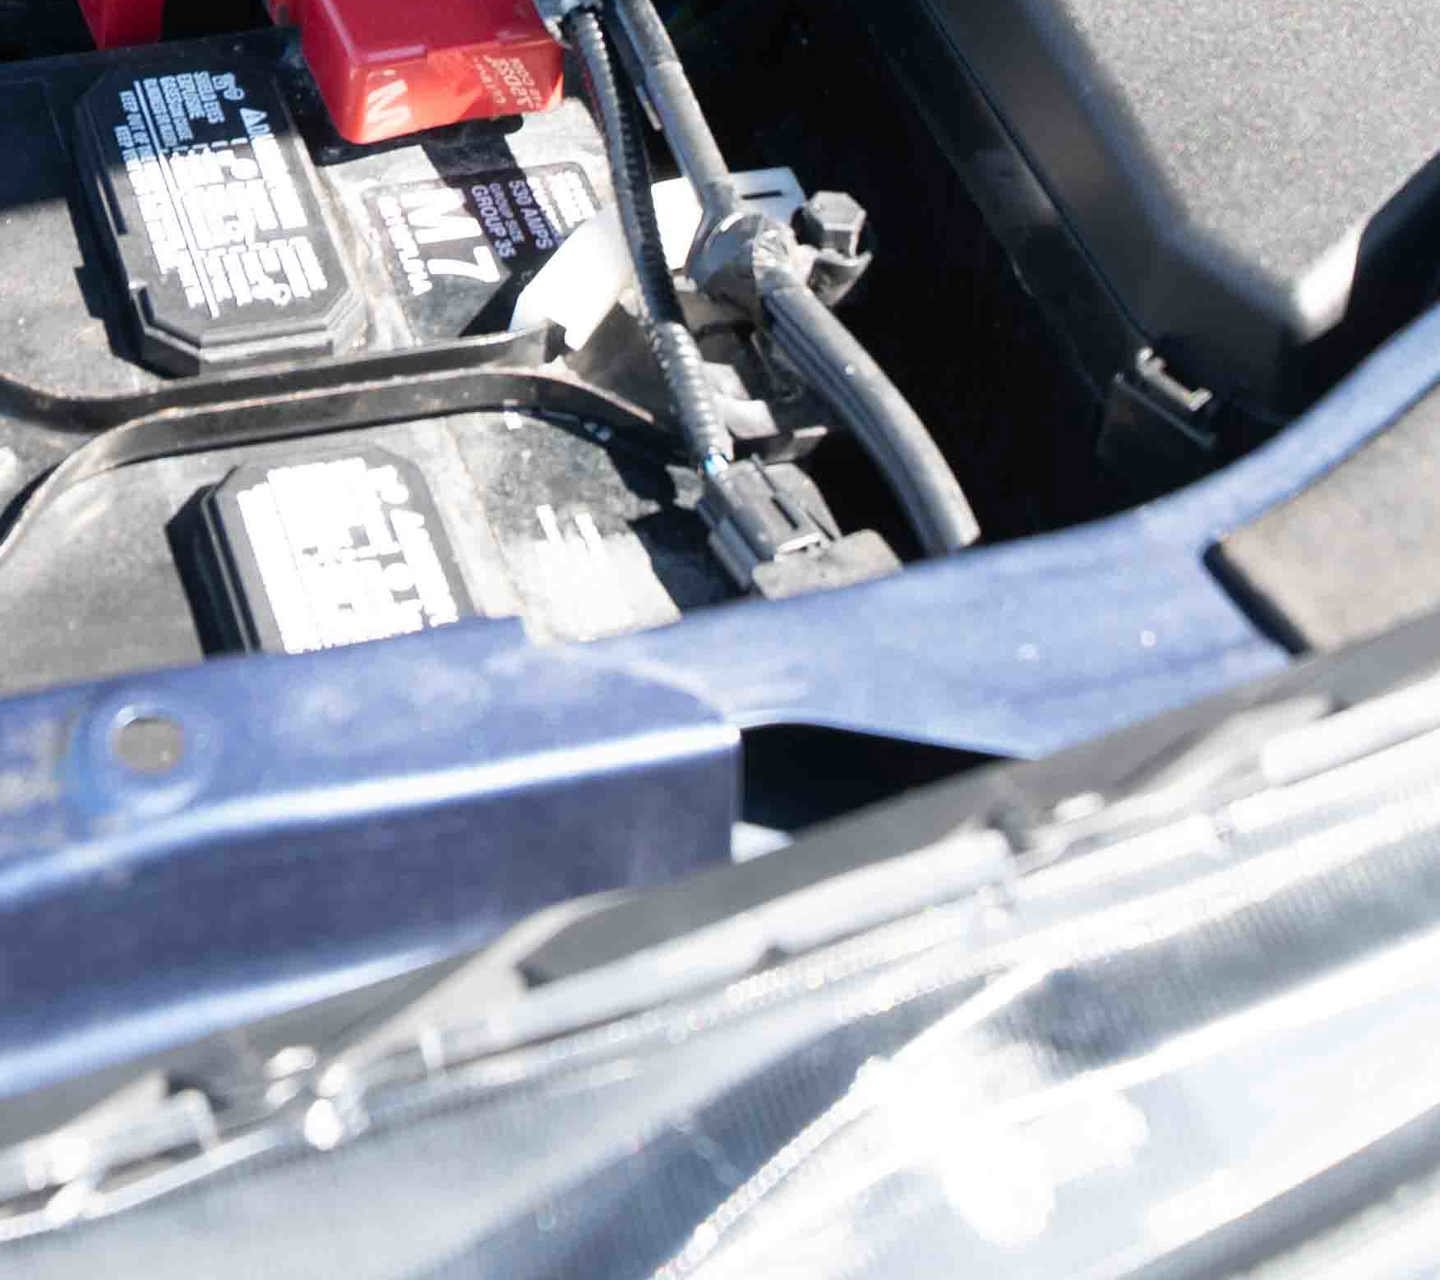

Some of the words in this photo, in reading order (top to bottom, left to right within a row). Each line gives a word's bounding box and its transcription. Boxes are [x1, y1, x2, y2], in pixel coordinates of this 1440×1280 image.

[470, 183, 507, 238] GROUP
[494, 238, 517, 260] 35
[508, 179, 532, 202] 530
[520, 204, 554, 250] AMPS
